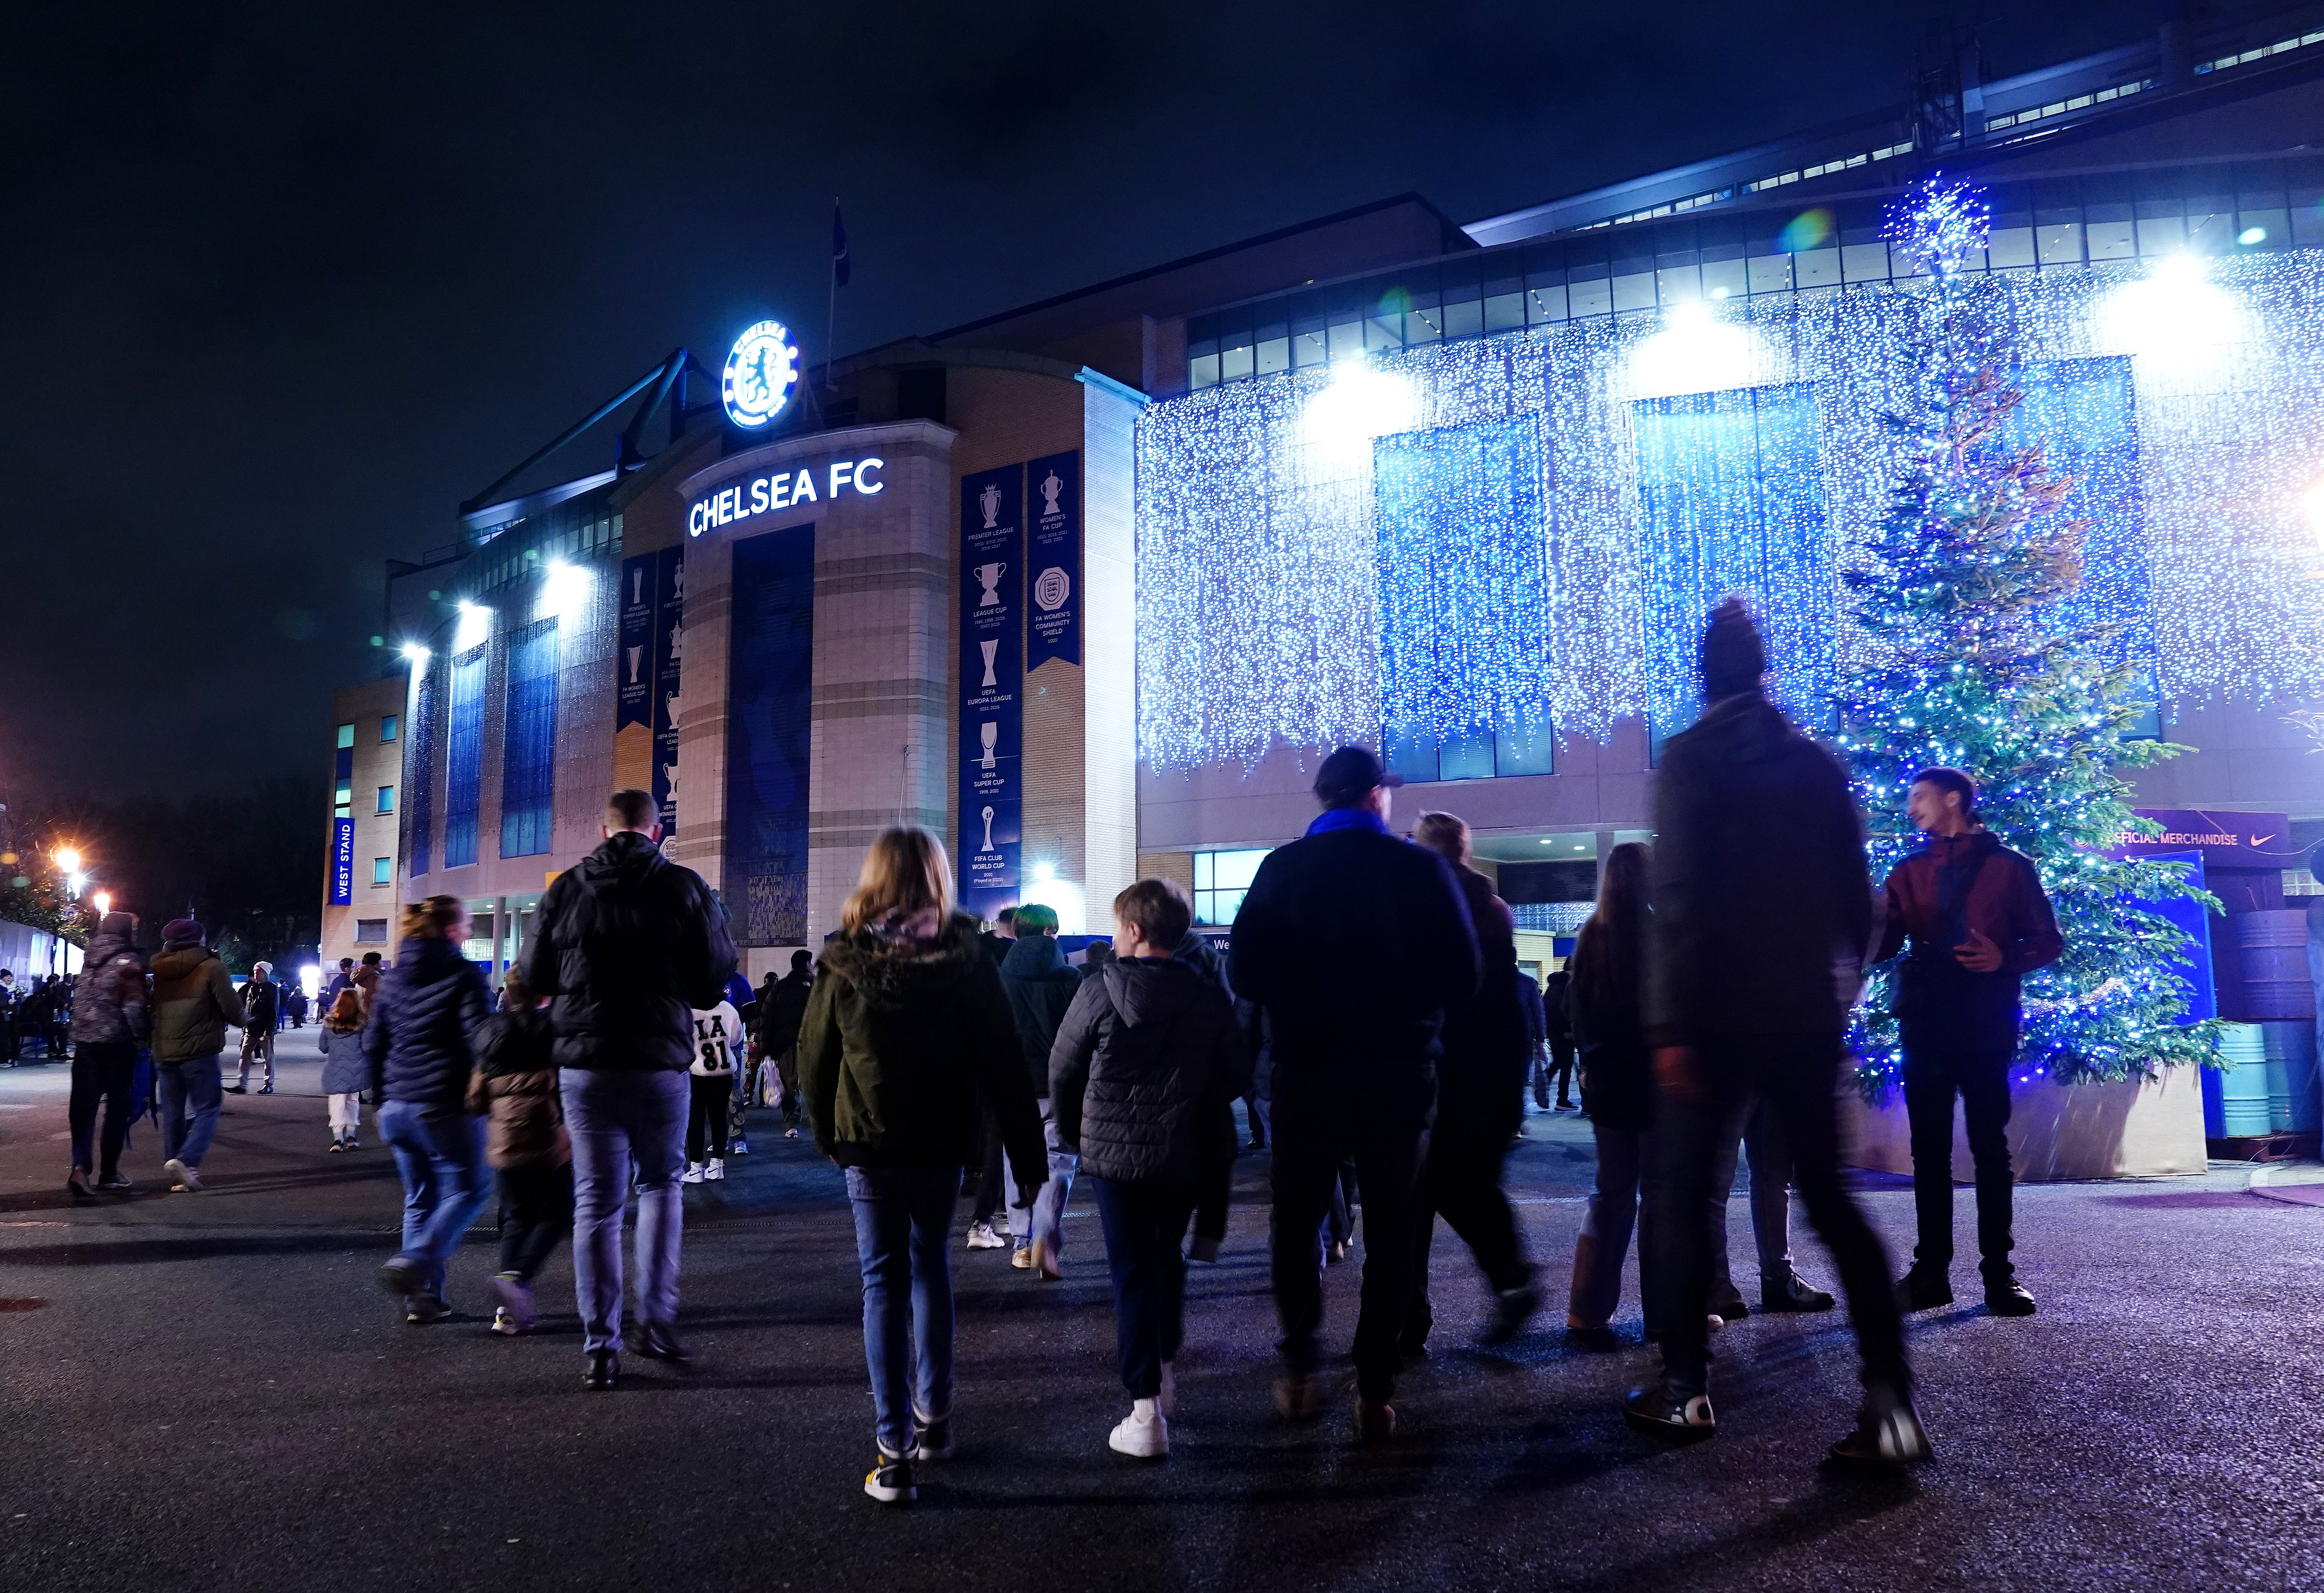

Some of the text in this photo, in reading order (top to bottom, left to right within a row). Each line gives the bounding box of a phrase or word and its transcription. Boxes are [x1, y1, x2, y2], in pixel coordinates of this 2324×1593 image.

[689, 458, 884, 537] CHELSEA FC
[1040, 514, 1066, 523] WOMEN'S
[968, 527, 1014, 541] PREMIER LEAGUE
[973, 609, 994, 617] LEAGUE
[1044, 611, 1070, 620] WOMEN'S
[1035, 619, 1070, 629] COMMUNITY
[1043, 628, 1063, 636] SHIELD
[991, 694, 1012, 702] LEAGUE
[2160, 833, 2238, 846] MERCHANDISE
[339, 825, 351, 897] WEST STAND
[694, 1015, 727, 1040] LA
[701, 1040, 730, 1071] 81
